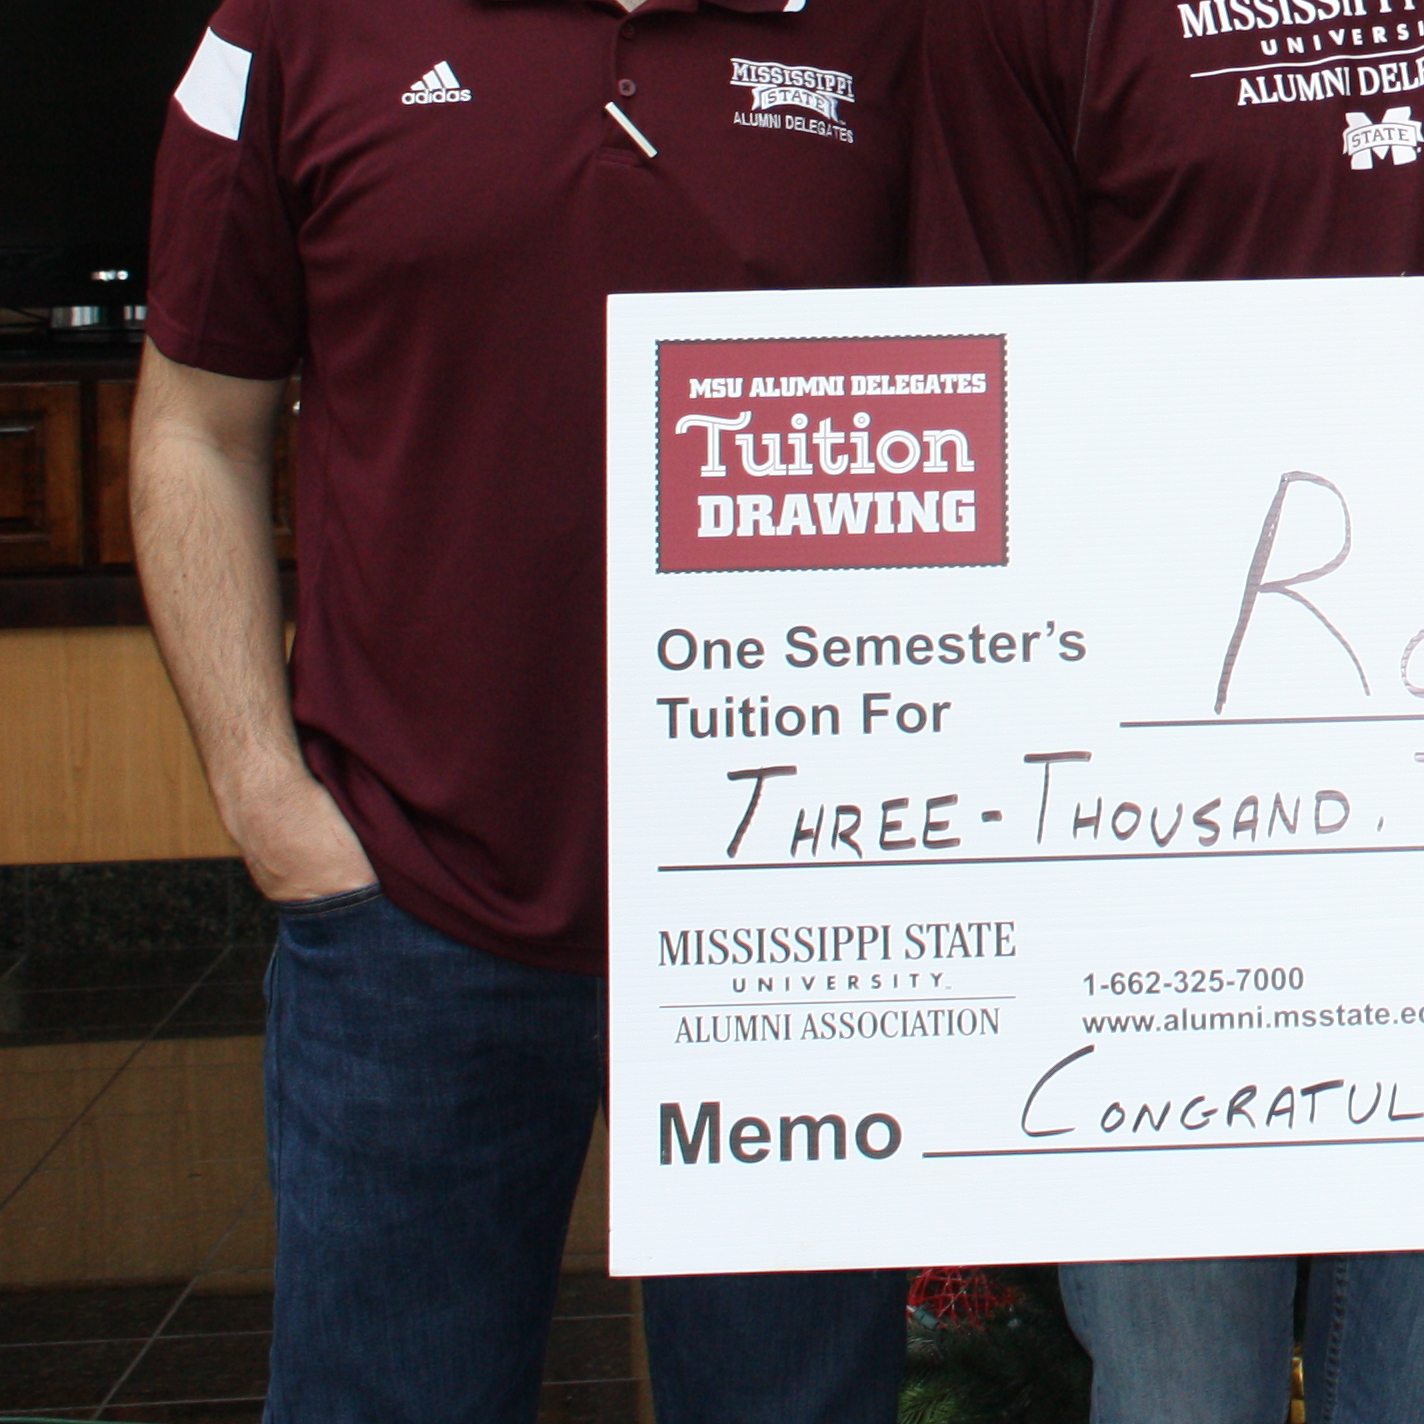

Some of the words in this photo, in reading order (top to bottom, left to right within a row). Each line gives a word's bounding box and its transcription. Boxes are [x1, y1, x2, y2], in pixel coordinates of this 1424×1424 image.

[401, 87, 472, 105] adidas
[732, 62, 855, 98] MISSISSIPPI
[1237, 66, 1351, 107] ALUMNI
[767, 89, 826, 113] STATE
[733, 111, 782, 130] ALUMNI
[785, 115, 854, 144] DELEGATES
[1351, 127, 1411, 149] STATE
[689, 378, 743, 399] MSU
[749, 375, 845, 398] ALUMNI
[851, 373, 987, 396] DELEGATES
[675, 410, 975, 478] Tuition
[697, 490, 977, 538] DRAWING
[657, 629, 765, 671] One
[785, 621, 1087, 668] Semester's
[657, 696, 840, 740] Tuition
[862, 692, 951, 735] For
[658, 925, 892, 966] MISSISSIPPI
[904, 921, 1017, 960] STATE
[733, 972, 944, 993] UNIVERSITY
[1082, 966, 1305, 996] 1-662-325-7000
[674, 1013, 792, 1044] ALUMNI
[801, 1007, 1000, 1040] ASSOCIATION
[658, 1101, 904, 1168] Memo
